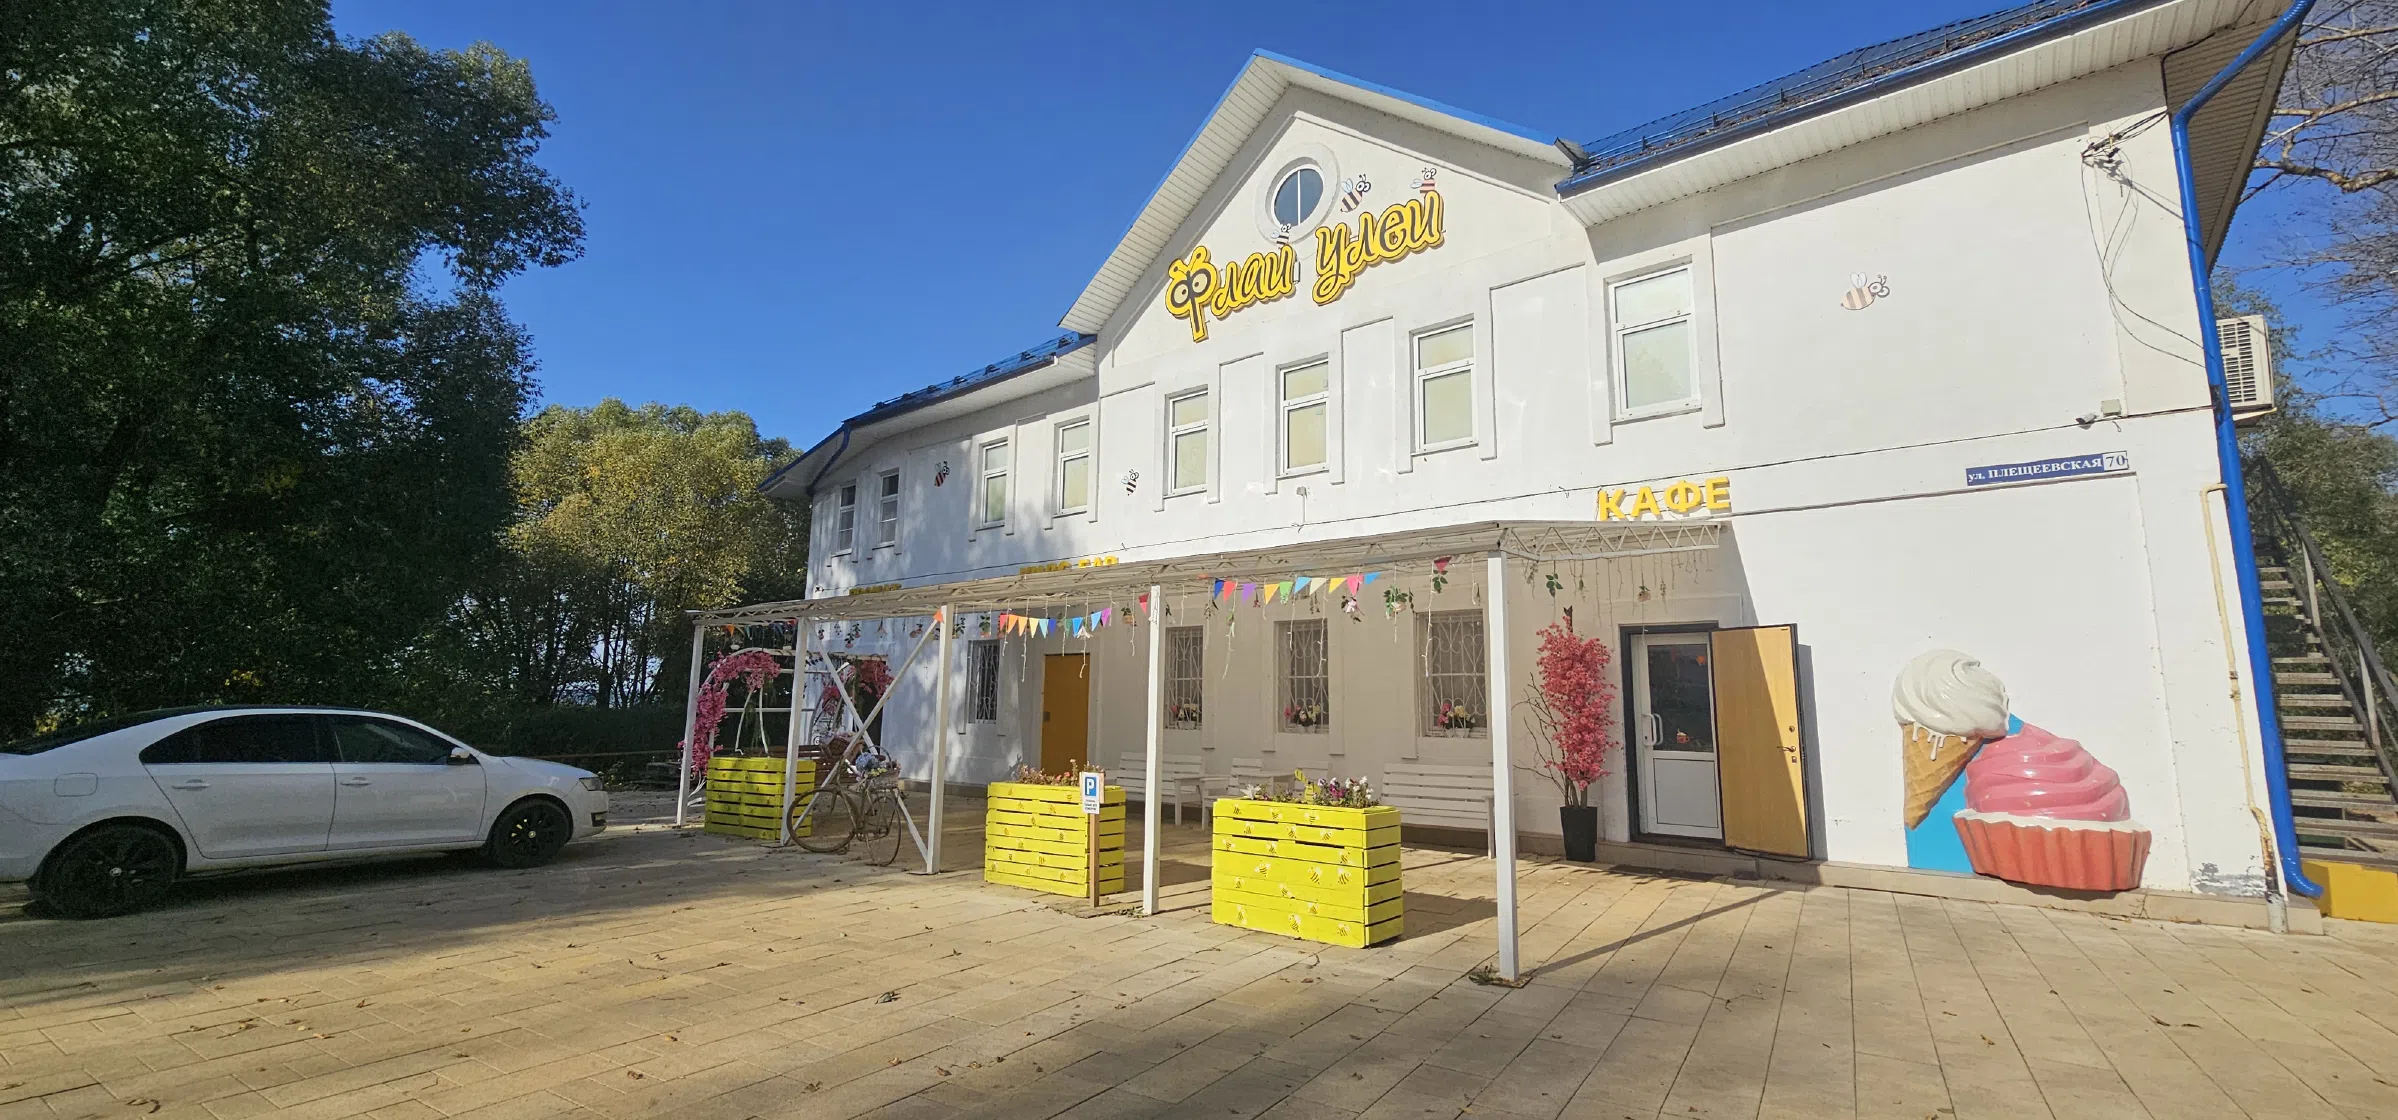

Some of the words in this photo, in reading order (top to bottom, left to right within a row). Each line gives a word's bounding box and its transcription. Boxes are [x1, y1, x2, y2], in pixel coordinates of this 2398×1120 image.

[1968, 473, 1986, 483] ул.
[1988, 458, 2103, 479] ПЛЕЩЕЕВСКАЯ
[2106, 454, 2126, 468] 70
[1598, 476, 1731, 521] КАФЕ
[1086, 778, 1095, 795] P
